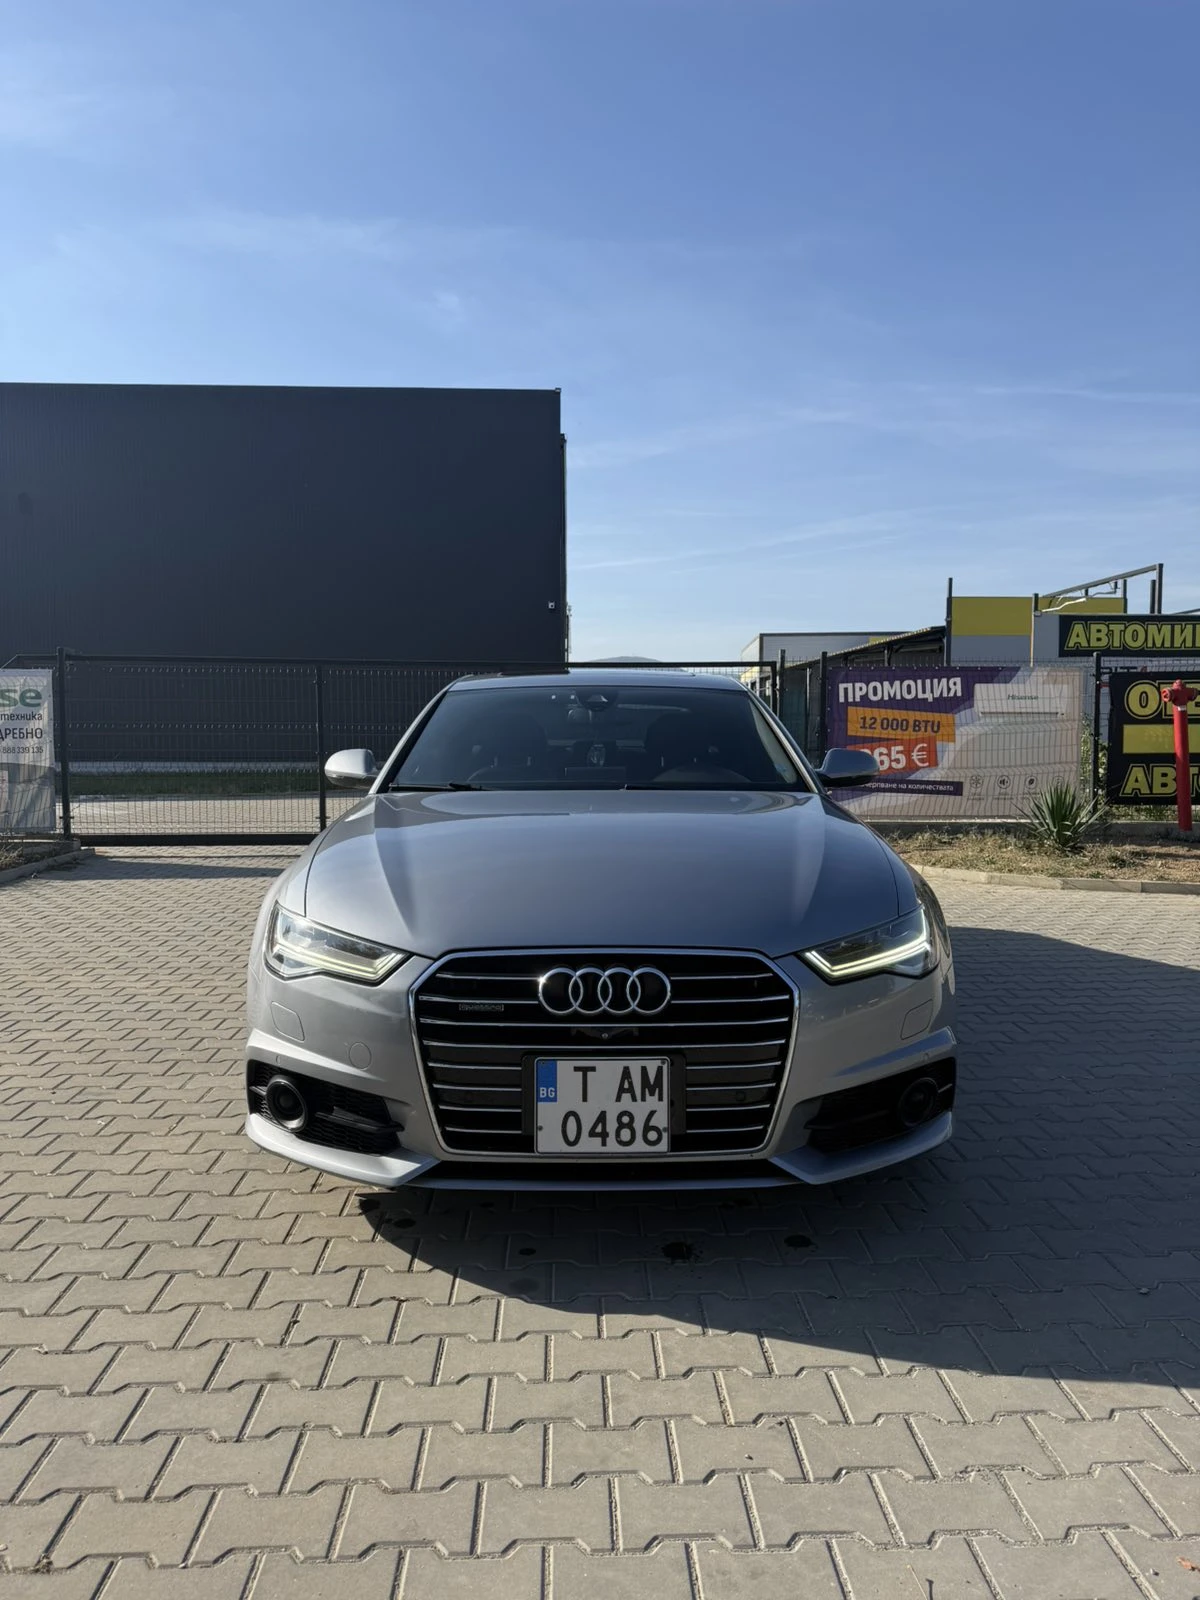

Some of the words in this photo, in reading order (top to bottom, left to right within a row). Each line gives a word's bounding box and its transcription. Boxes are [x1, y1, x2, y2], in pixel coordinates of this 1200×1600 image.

[838, 677, 962, 702] ПРОМОЦИЯ
[859, 716, 877, 730] 12
[880, 718, 909, 732] 000
[912, 719, 941, 734] BTU
[860, 746, 906, 771] 65
[862, 781, 898, 790] черпване
[908, 784, 954, 792] количествата
[1121, 764, 1200, 796] АВ
[539, 1087, 556, 1099] BG
[573, 1066, 597, 1102] T
[615, 1066, 664, 1102] AM
[560, 1110, 663, 1147] 0486
